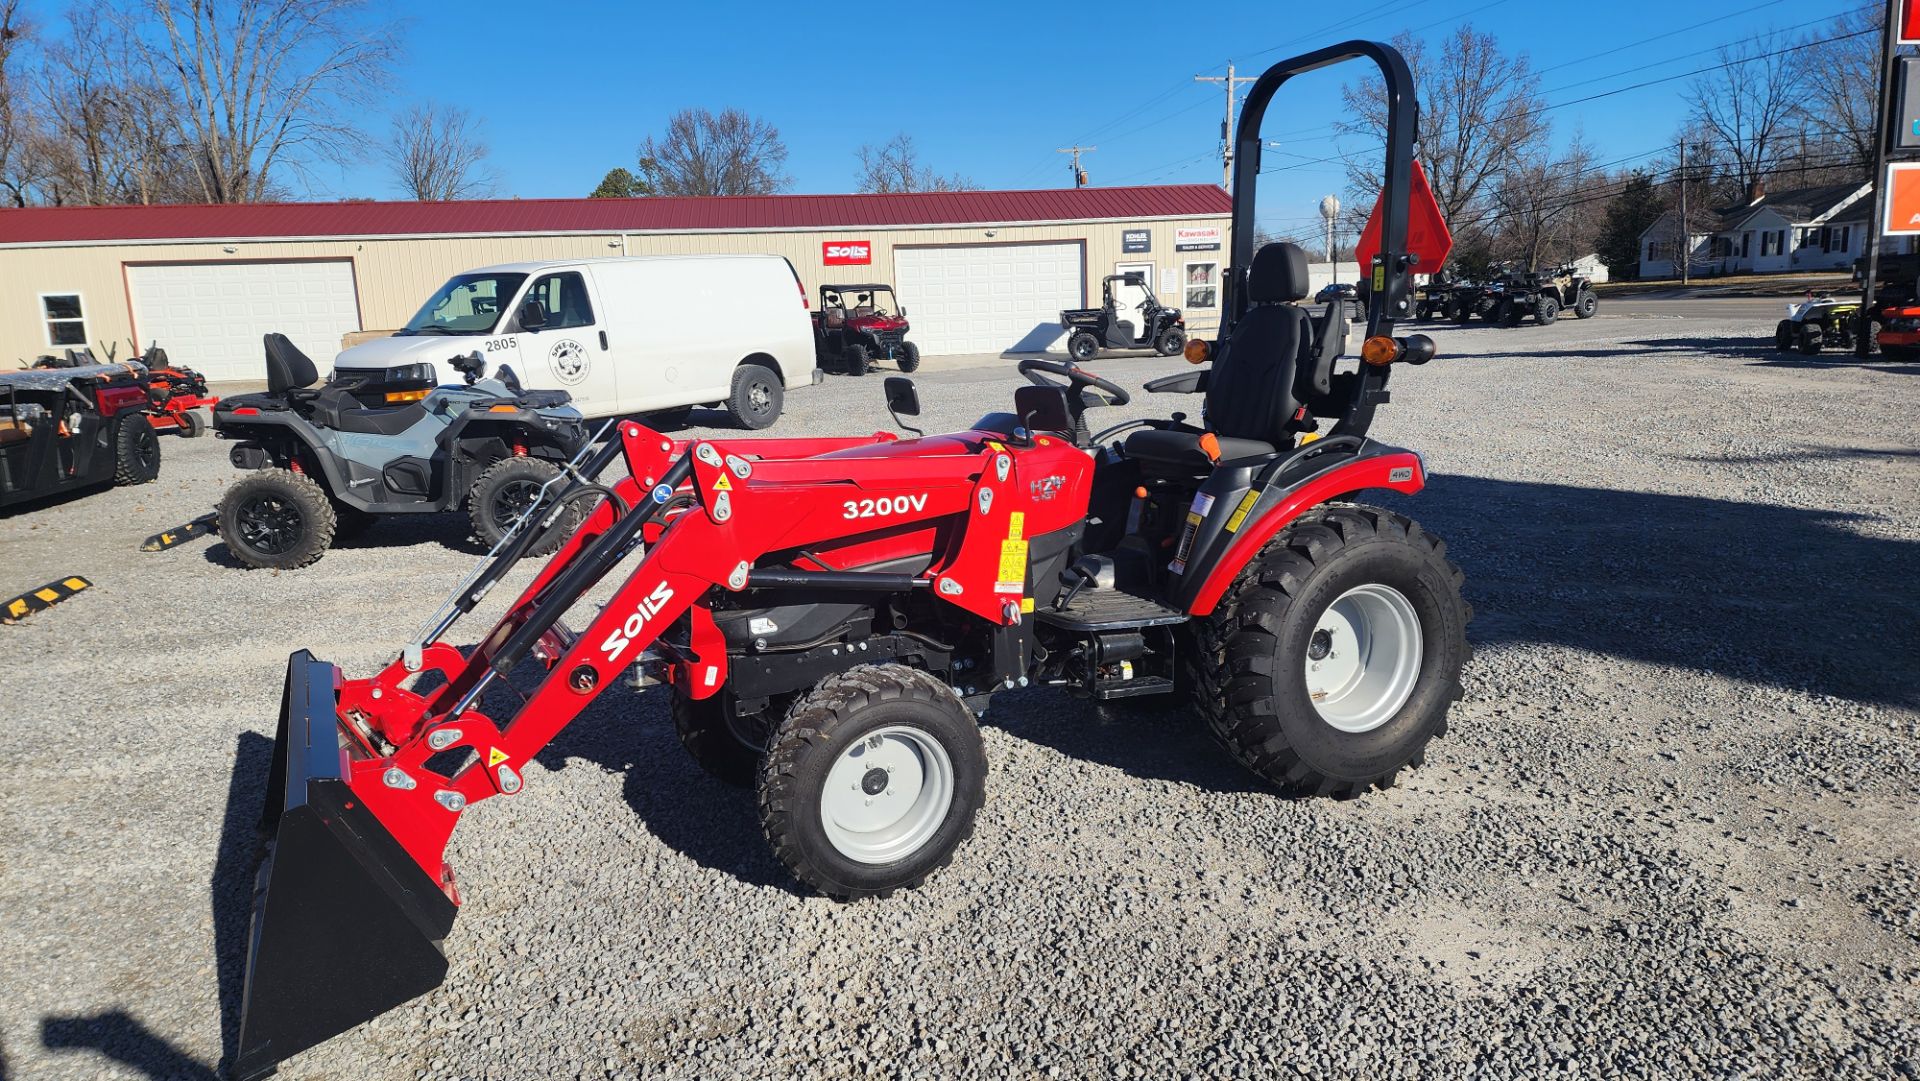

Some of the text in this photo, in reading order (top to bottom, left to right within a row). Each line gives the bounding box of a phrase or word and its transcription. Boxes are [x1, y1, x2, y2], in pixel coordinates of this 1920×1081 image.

[1178, 229, 1218, 238] Kawasaki
[485, 337, 517, 352] 2805
[1392, 470, 1410, 478] 4WD
[843, 493, 928, 519] 3200V
